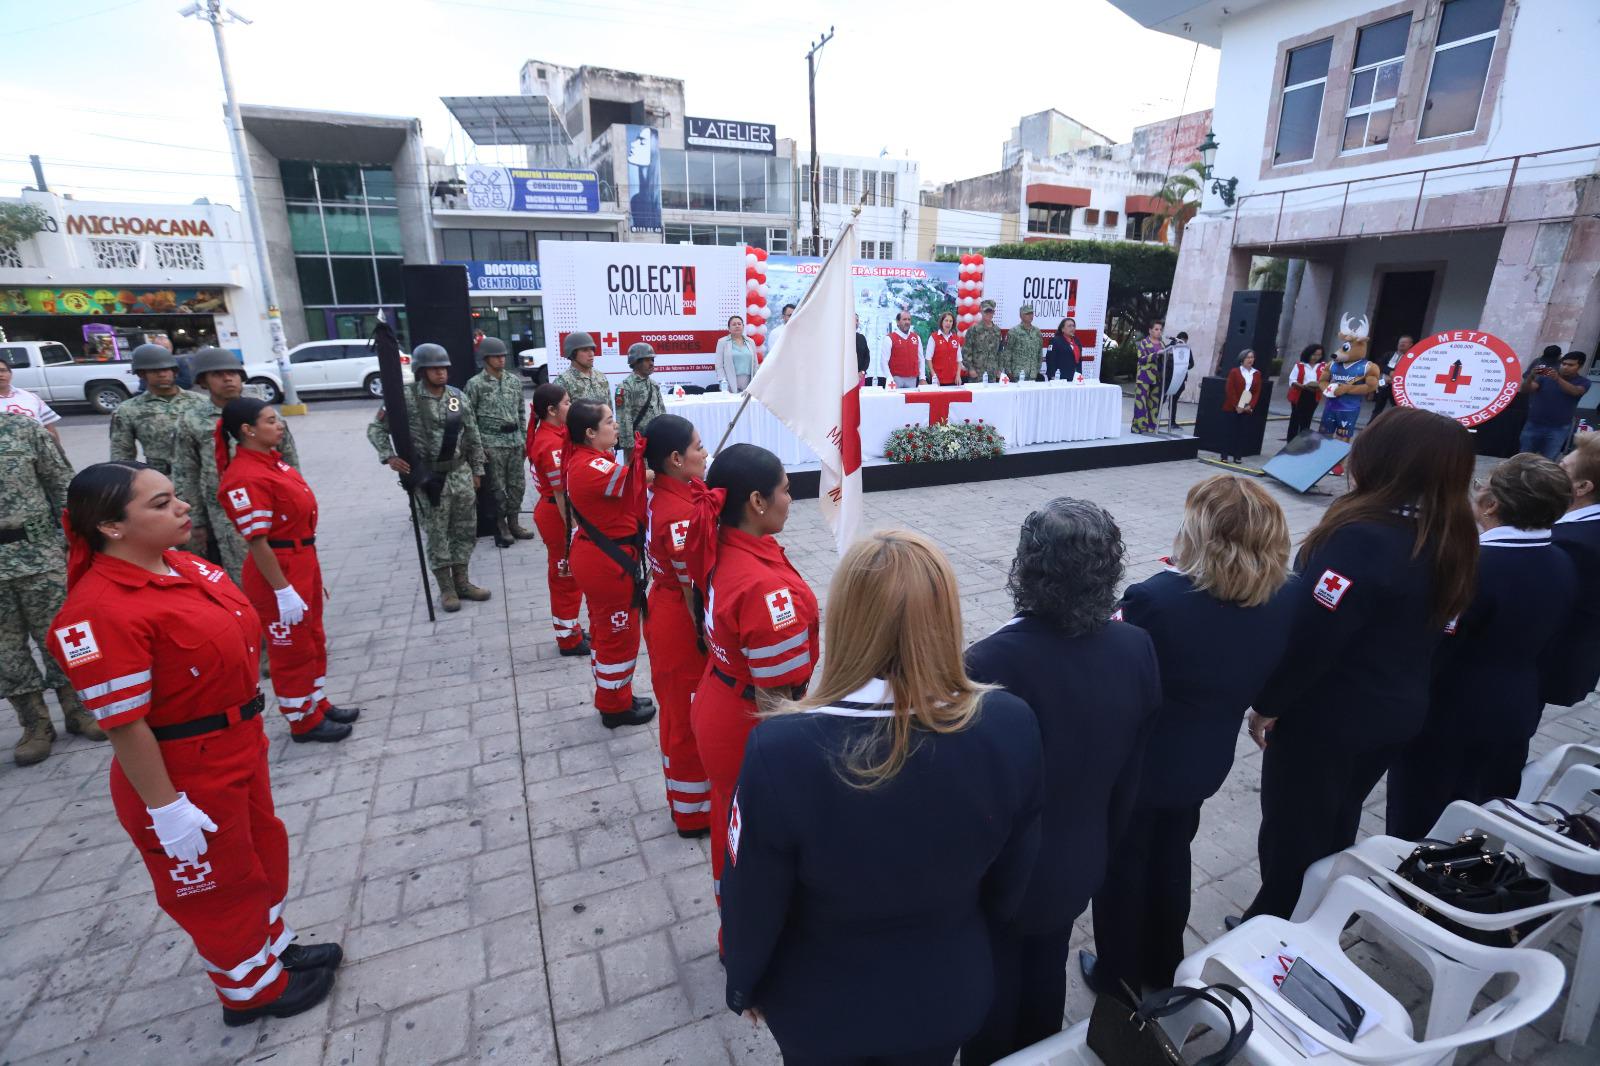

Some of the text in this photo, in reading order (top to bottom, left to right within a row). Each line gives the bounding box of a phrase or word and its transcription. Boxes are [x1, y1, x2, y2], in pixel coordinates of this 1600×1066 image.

[532, 182, 578, 191] CONSULTORIO
[66, 214, 214, 237] MICHOACANA
[484, 263, 538, 276] DOCTORES
[873, 267, 911, 277] SIEMPRE
[478, 276, 519, 290] CENTRO
[520, 277, 536, 290] DE
[607, 263, 696, 293] COLECTA
[1023, 276, 1078, 300] COLECTA
[608, 293, 681, 316] NACIONAL
[641, 334, 694, 343] TODOS SOMOS
[1438, 331, 1488, 345] META
[449, 397, 460, 412] 8
[1471, 381, 1519, 424] DE PESOS
